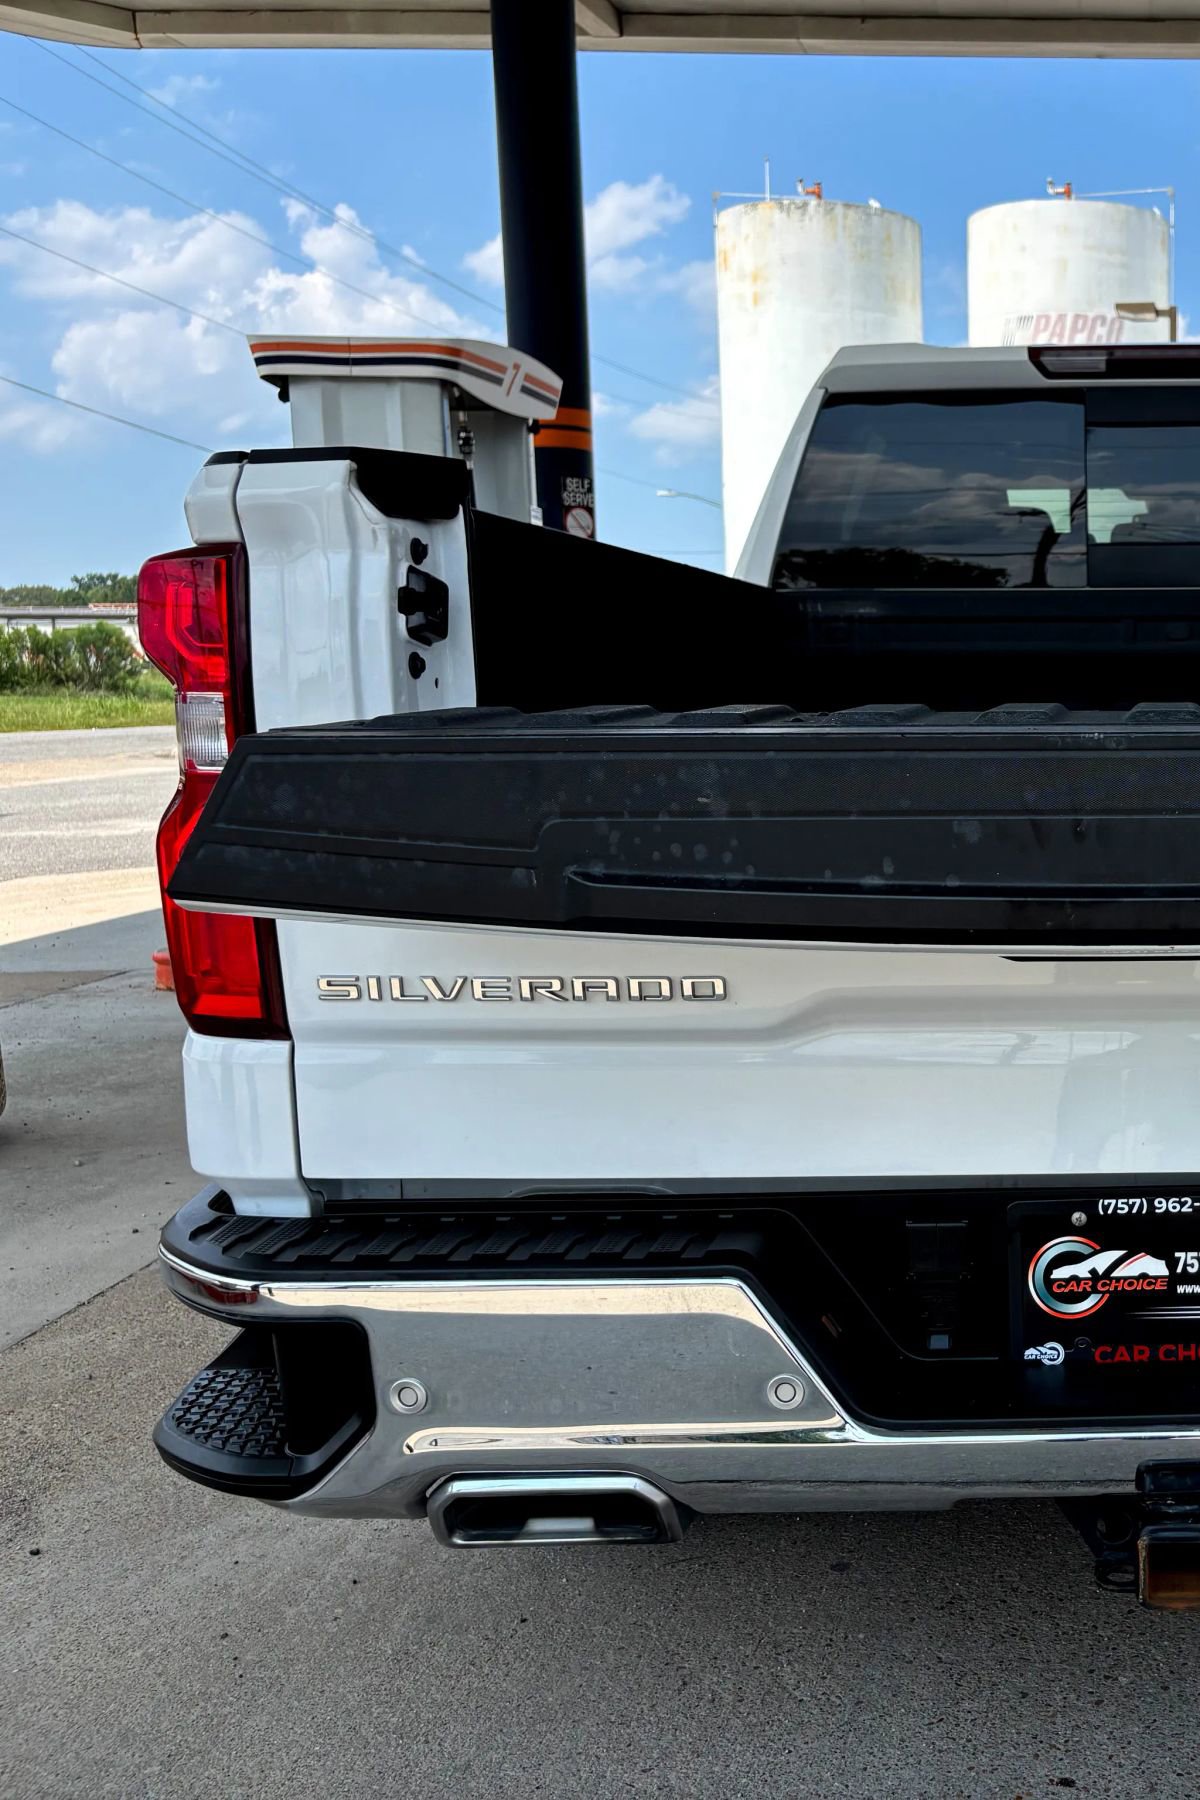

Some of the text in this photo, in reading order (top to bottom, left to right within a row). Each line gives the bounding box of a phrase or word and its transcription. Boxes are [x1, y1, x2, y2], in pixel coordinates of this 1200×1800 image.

[1031, 313, 1124, 345] PAPCO
[506, 362, 521, 397] 7
[565, 477, 590, 492] SELF
[562, 492, 594, 508] SERVE
[316, 975, 728, 1001] SILVERADO
[1098, 1198, 1147, 1215] (757)
[1052, 1278, 1168, 1293] CAR CHOICE
[1095, 1345, 1150, 1363] CAR
